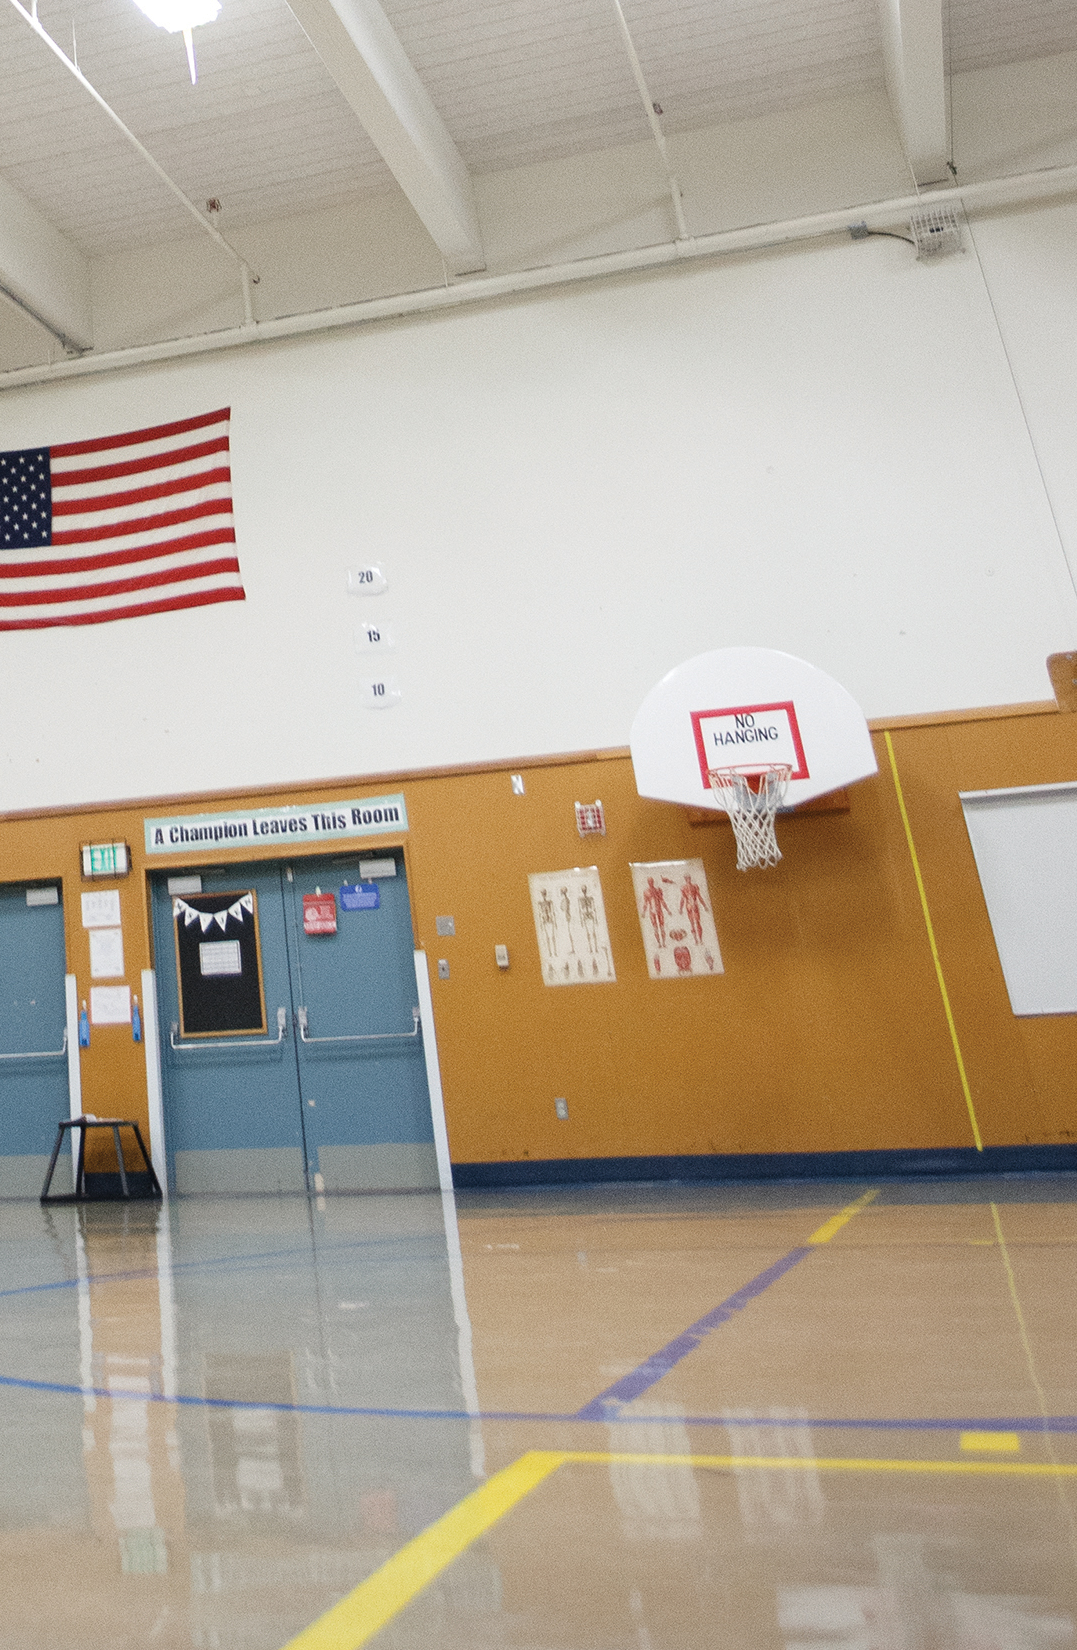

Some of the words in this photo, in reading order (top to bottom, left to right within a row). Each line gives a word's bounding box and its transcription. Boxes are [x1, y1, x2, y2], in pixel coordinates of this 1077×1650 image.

[358, 570, 373, 583] 20
[367, 630, 380, 642] 15
[372, 683, 385, 696] 10
[735, 714, 755, 728] NO
[713, 726, 779, 746] HANGING
[154, 828, 165, 845] A
[169, 821, 248, 844] Champion
[252, 817, 308, 837] Leaves
[312, 813, 347, 832] This
[351, 806, 400, 826] Room
[90, 847, 117, 872] EXIT
